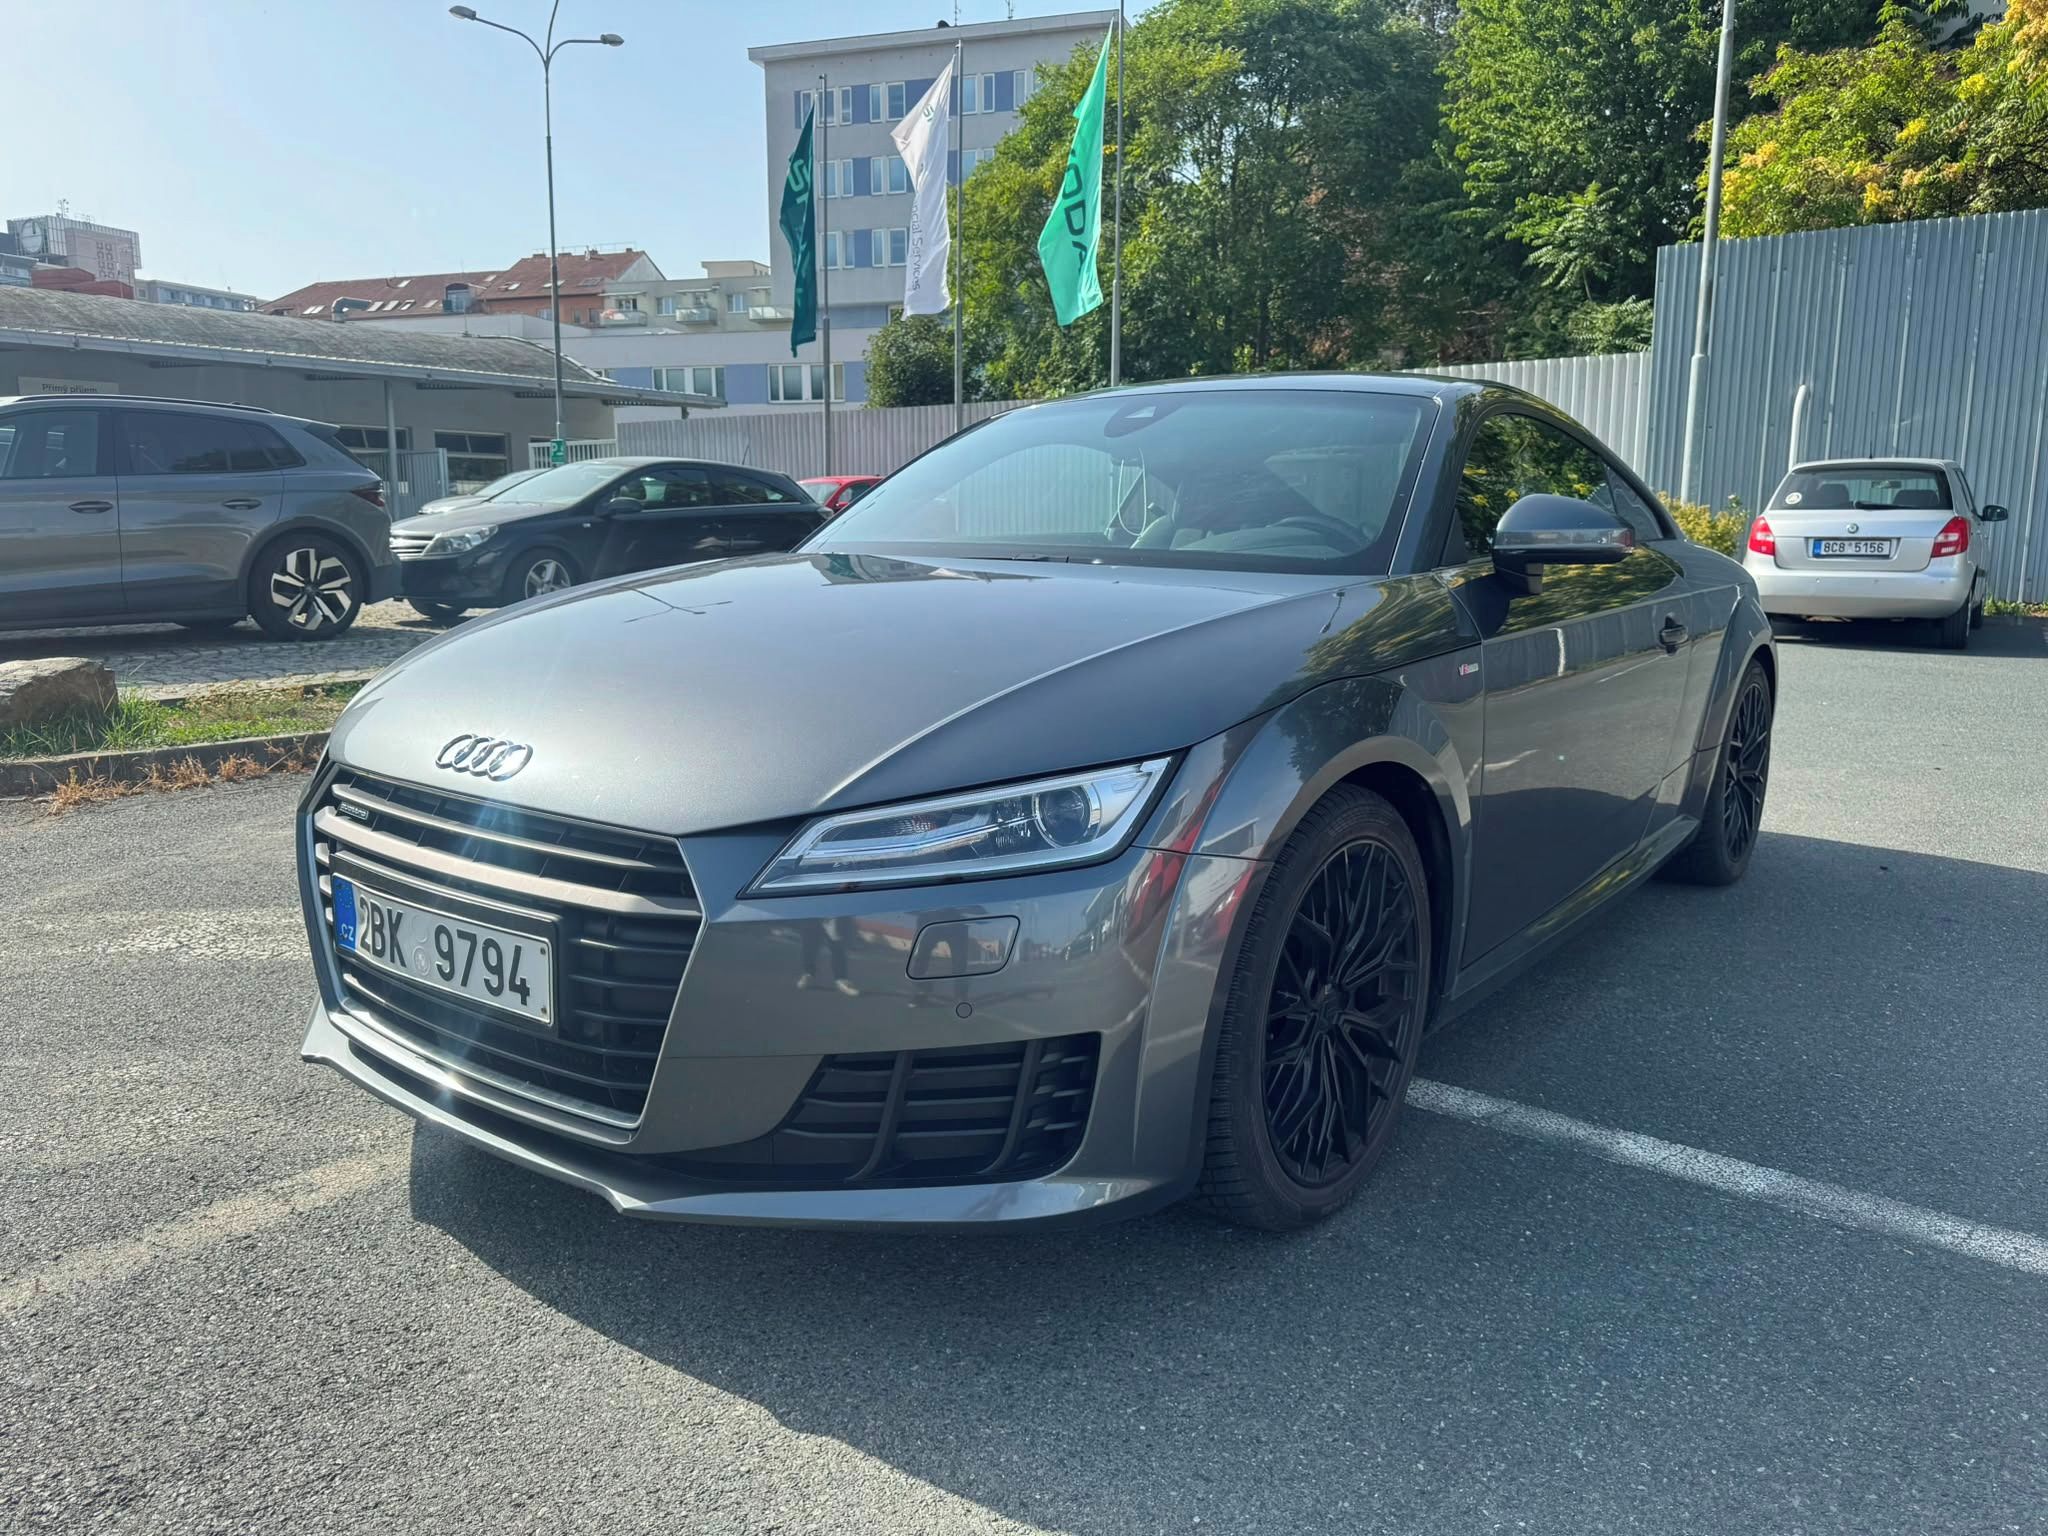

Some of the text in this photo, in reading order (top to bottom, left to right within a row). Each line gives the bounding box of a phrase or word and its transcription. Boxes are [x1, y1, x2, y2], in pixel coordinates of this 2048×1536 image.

[1062, 148, 1089, 276] ODA
[1823, 542, 1885, 553] 8C8 5156
[341, 923, 355, 941] CZ
[359, 894, 530, 1006] 2BK 9794
